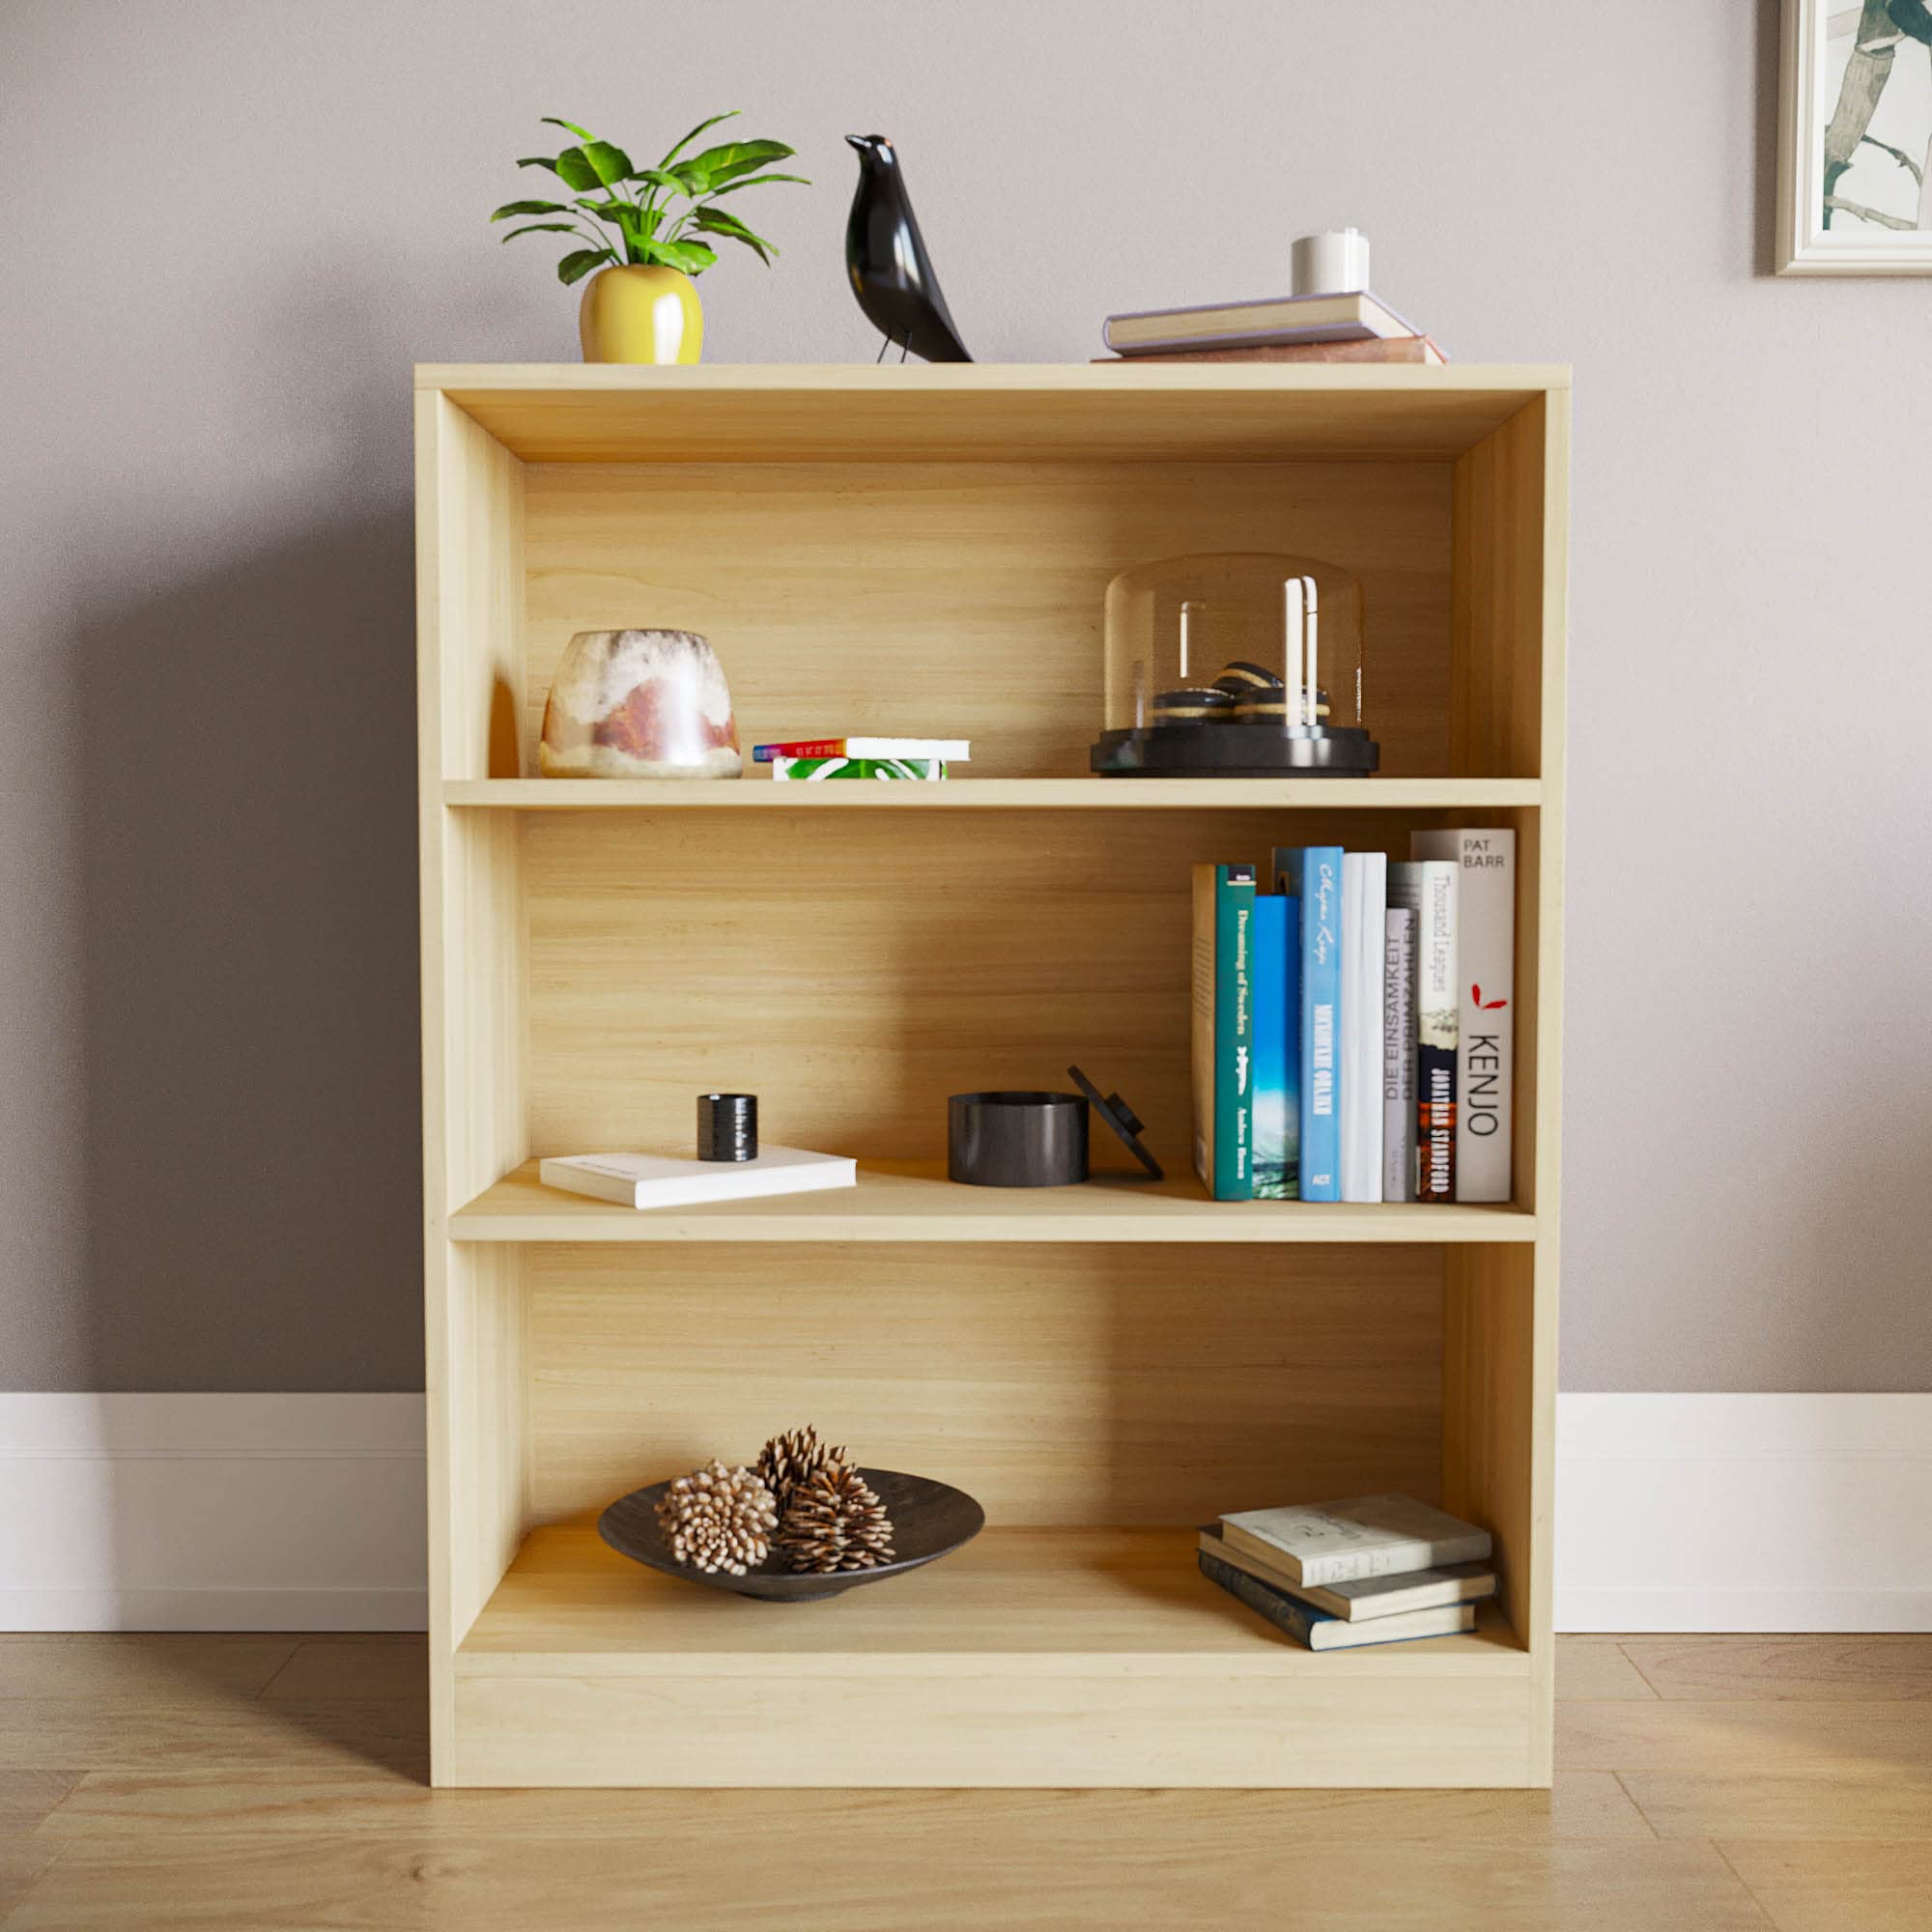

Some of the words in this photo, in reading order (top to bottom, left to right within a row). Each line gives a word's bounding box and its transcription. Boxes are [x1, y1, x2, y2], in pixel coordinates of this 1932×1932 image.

[1463, 839, 1490, 852] PAT
[1463, 855, 1504, 868] BARR
[1386, 935, 1400, 1061] EINSAMKEIT
[1403, 917, 1415, 1052] PRIMZAHLEN
[1386, 1067, 1400, 1100] DIE
[1403, 1059, 1413, 1101] DER
[1431, 1067, 1450, 1125] JONATHAN
[1467, 1035, 1499, 1137] KENJO
[1430, 1128, 1450, 1193] STANDFORD
